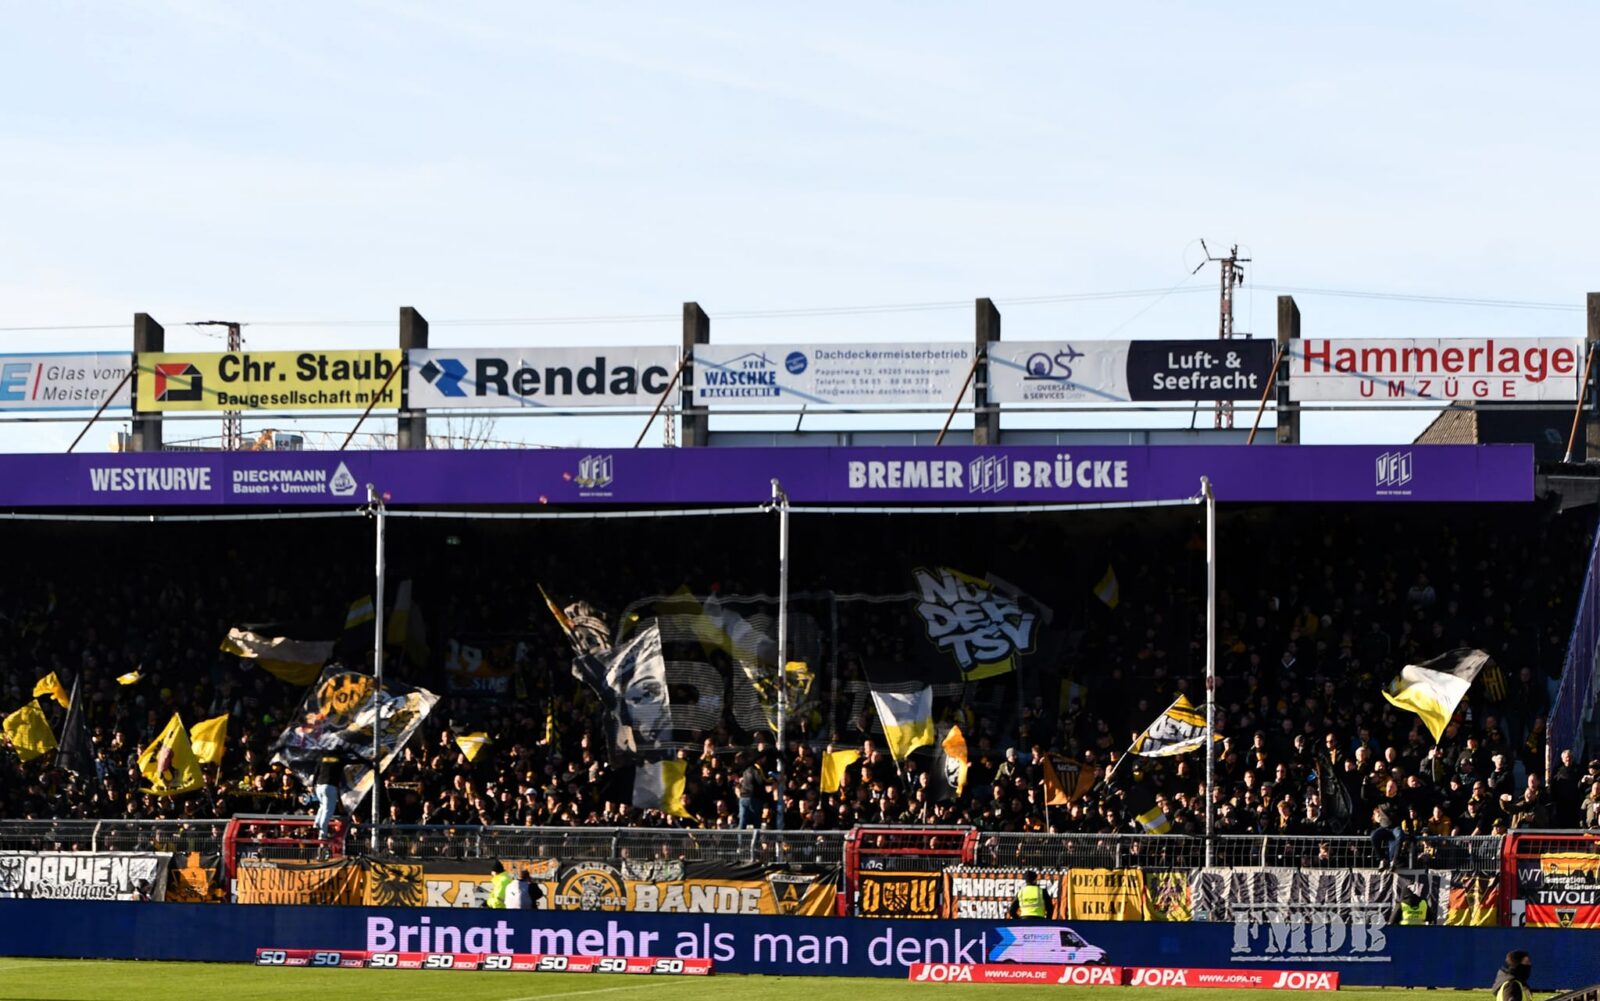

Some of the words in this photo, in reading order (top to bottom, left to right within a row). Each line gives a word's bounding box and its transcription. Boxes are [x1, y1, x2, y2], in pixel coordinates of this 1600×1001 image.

[814, 349, 968, 360] Dachdeckermeisterbetrieb
[1168, 351, 1220, 370] Luft-
[1225, 352, 1242, 370] &
[1303, 339, 1575, 383] Hammerlage
[46, 366, 86, 381] Glas
[93, 368, 127, 381] vom
[218, 354, 286, 383] Chr.
[296, 352, 394, 382] Staub
[743, 360, 766, 370] SVEN
[475, 356, 670, 397] Rendac
[704, 370, 777, 386] WASCHKE
[1153, 371, 1258, 391] Seefracht
[43, 386, 108, 401] Meister
[1360, 376, 1516, 398] UMZÜGE
[217, 391, 351, 408] Baugesellschaft
[355, 389, 393, 404] mbH
[232, 469, 327, 483] DIECKMANN
[848, 460, 964, 489] BREMER
[1013, 454, 1129, 489] BRÜCKE
[1376, 451, 1413, 486] VFL
[90, 466, 211, 492] WESTKURVE
[233, 483, 270, 494] Bauen
[280, 482, 327, 494] Umwelt
[24, 856, 130, 892] AACHEN
[1518, 868, 1541, 883] W7
[634, 883, 762, 914] BANDE
[1538, 890, 1596, 905] TIVOLI
[367, 916, 514, 953] Bringt
[531, 920, 660, 958] mehr
[675, 923, 736, 961] als
[754, 932, 849, 965] man
[868, 927, 987, 966] denkt
[916, 965, 973, 981] JOPA
[984, 970, 1047, 979] WWW.JOPA.DE
[1058, 966, 1115, 984] JOPA
[1131, 969, 1188, 986] JOPA
[1199, 974, 1262, 984] WWW.JOPA.DE
[1272, 971, 1331, 990] JOPA
